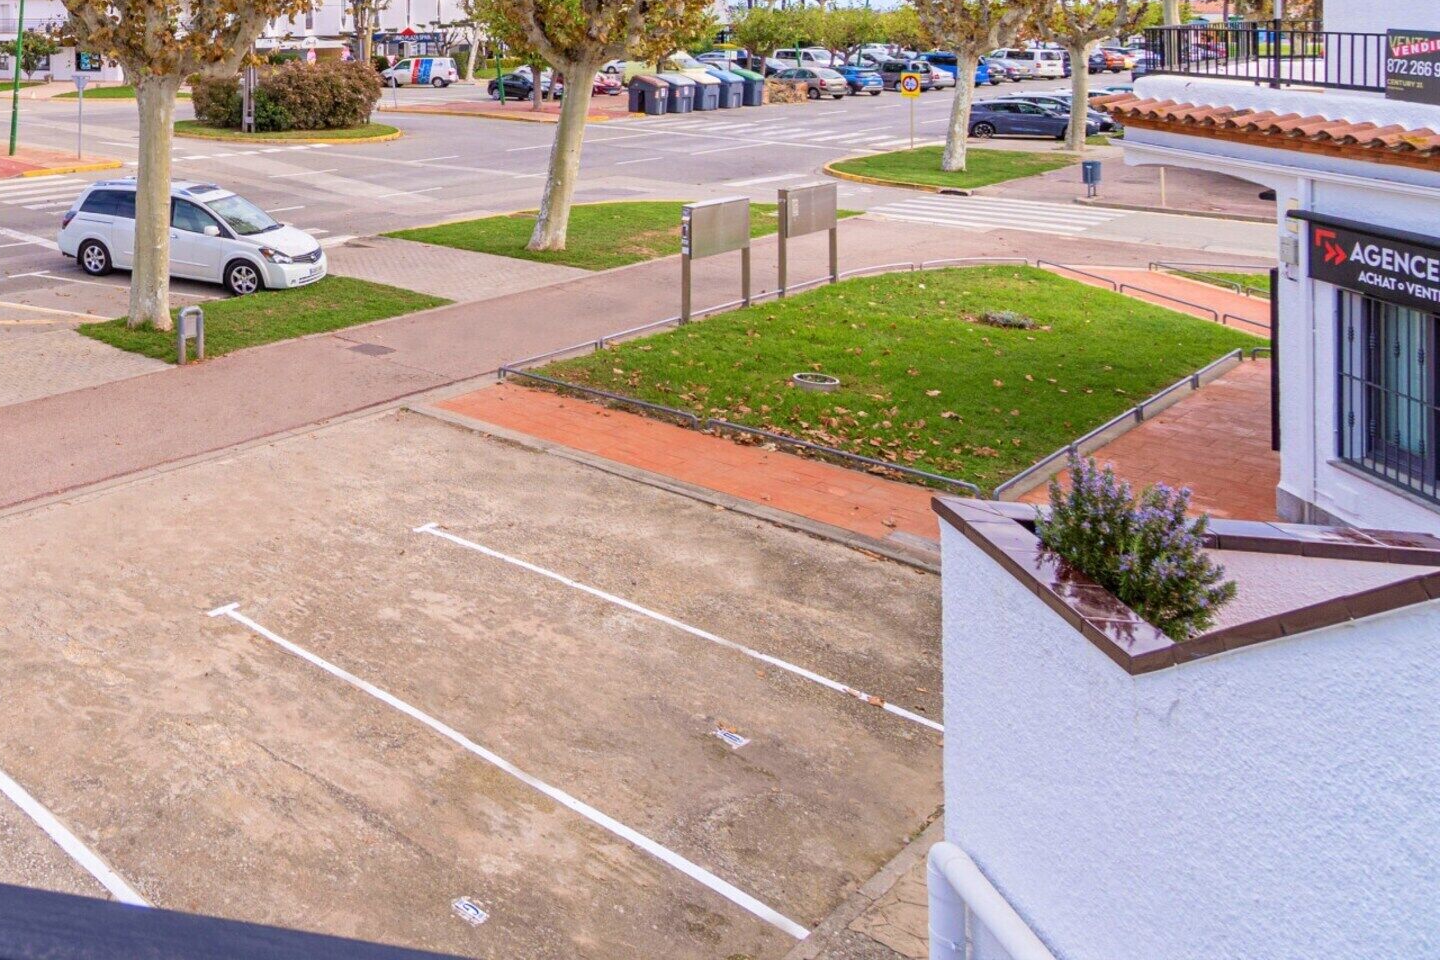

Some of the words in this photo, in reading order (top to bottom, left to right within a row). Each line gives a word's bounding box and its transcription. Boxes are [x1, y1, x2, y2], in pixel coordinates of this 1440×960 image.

[1388, 35, 1429, 48] VENT
[1387, 58, 1408, 74] 872
[1409, 60, 1432, 76] 266
[1349, 241, 1440, 282] AGENCE
[1358, 270, 1397, 291] ACHAT
